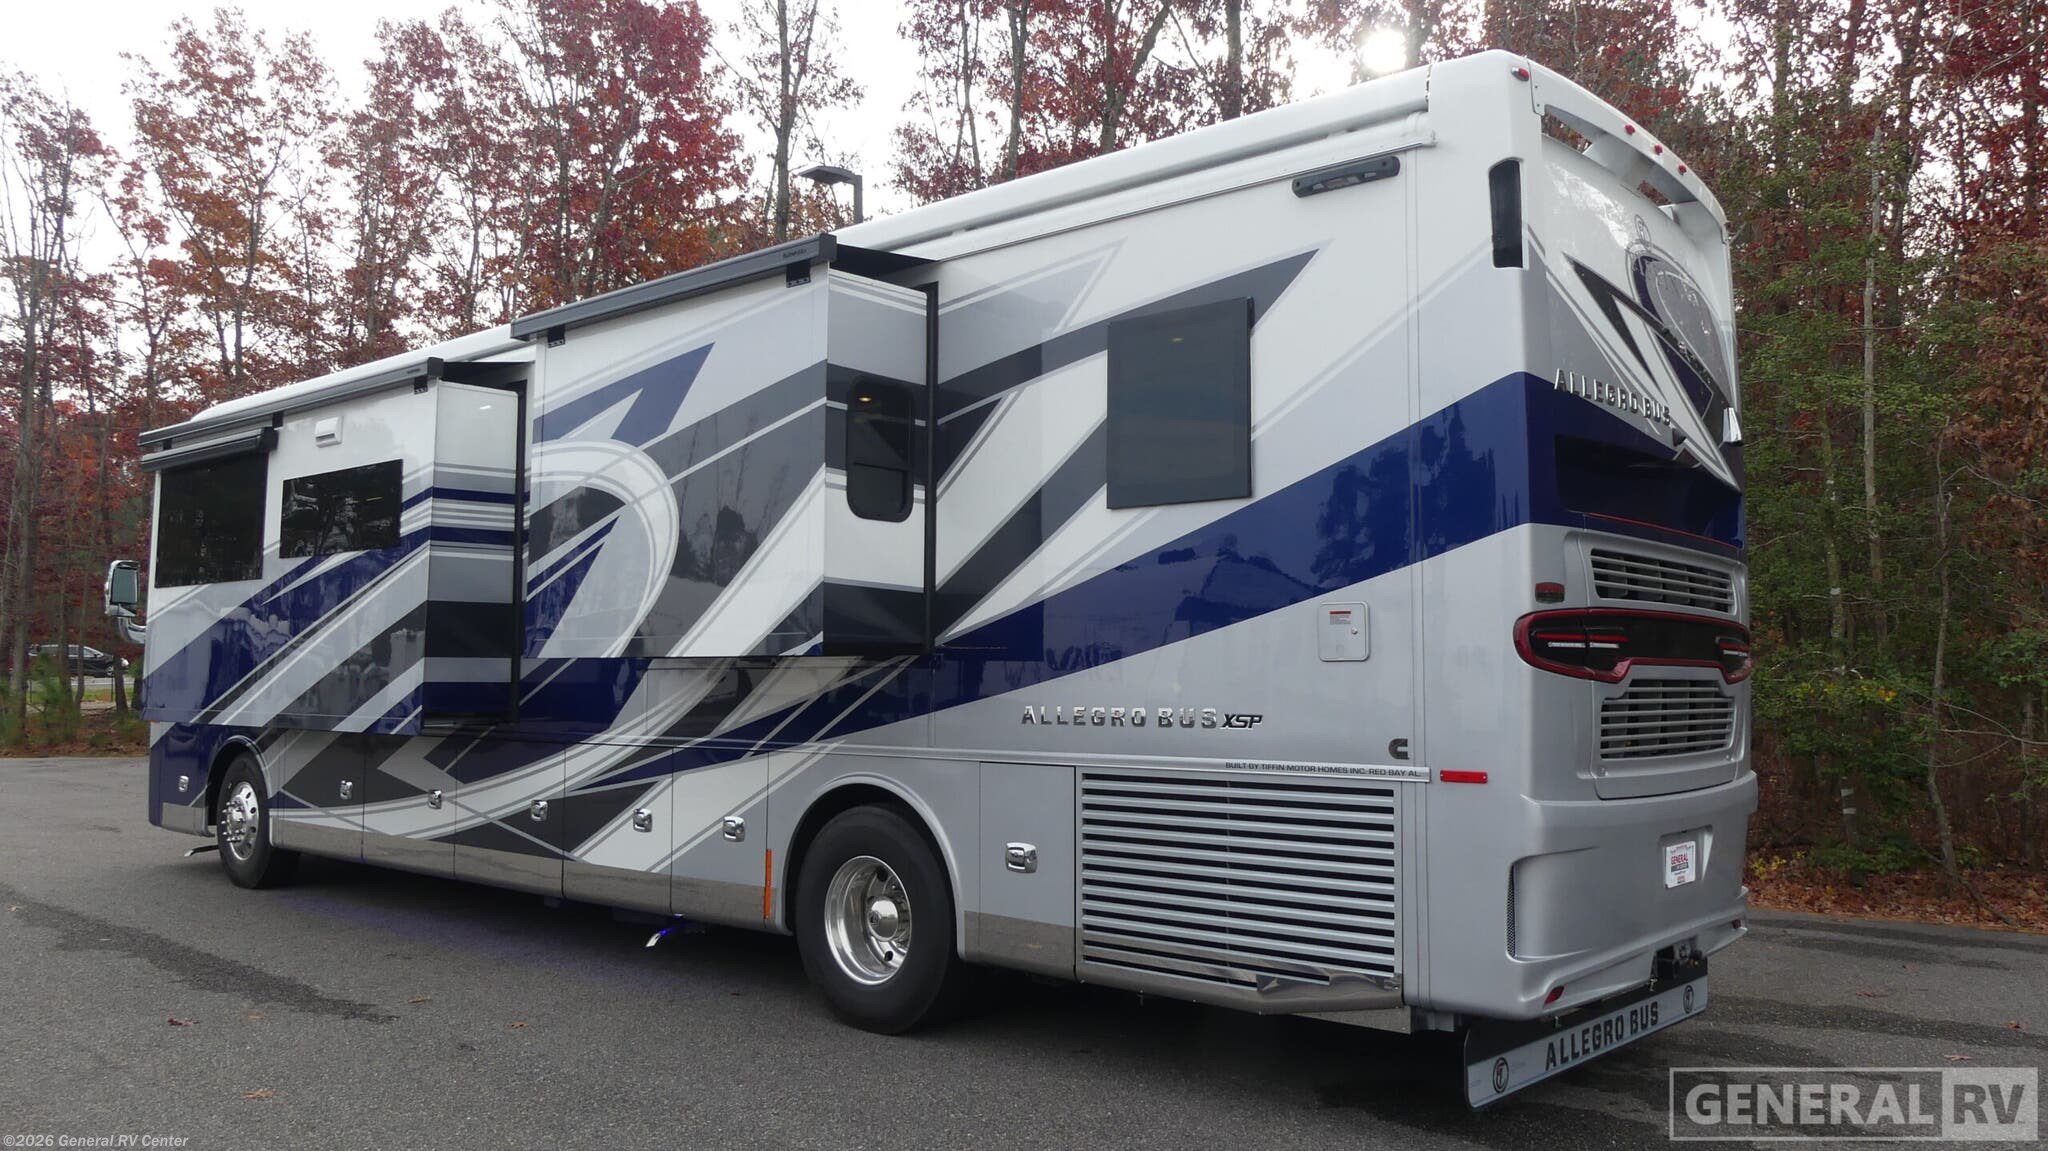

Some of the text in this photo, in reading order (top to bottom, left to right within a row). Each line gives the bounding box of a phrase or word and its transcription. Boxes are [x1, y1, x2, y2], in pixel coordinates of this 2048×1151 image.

[1554, 368, 1670, 426] ALLEGRO BUS
[1021, 705, 1263, 730] ALLEGRO BUS XSP
[1225, 761, 1247, 769] BUILT
[1261, 763, 1285, 771] TIFFIN
[1286, 764, 1316, 772] MOTOR
[1317, 765, 1348, 773] HOMES
[1545, 1001, 1659, 1071] ALLEGRO BUS
